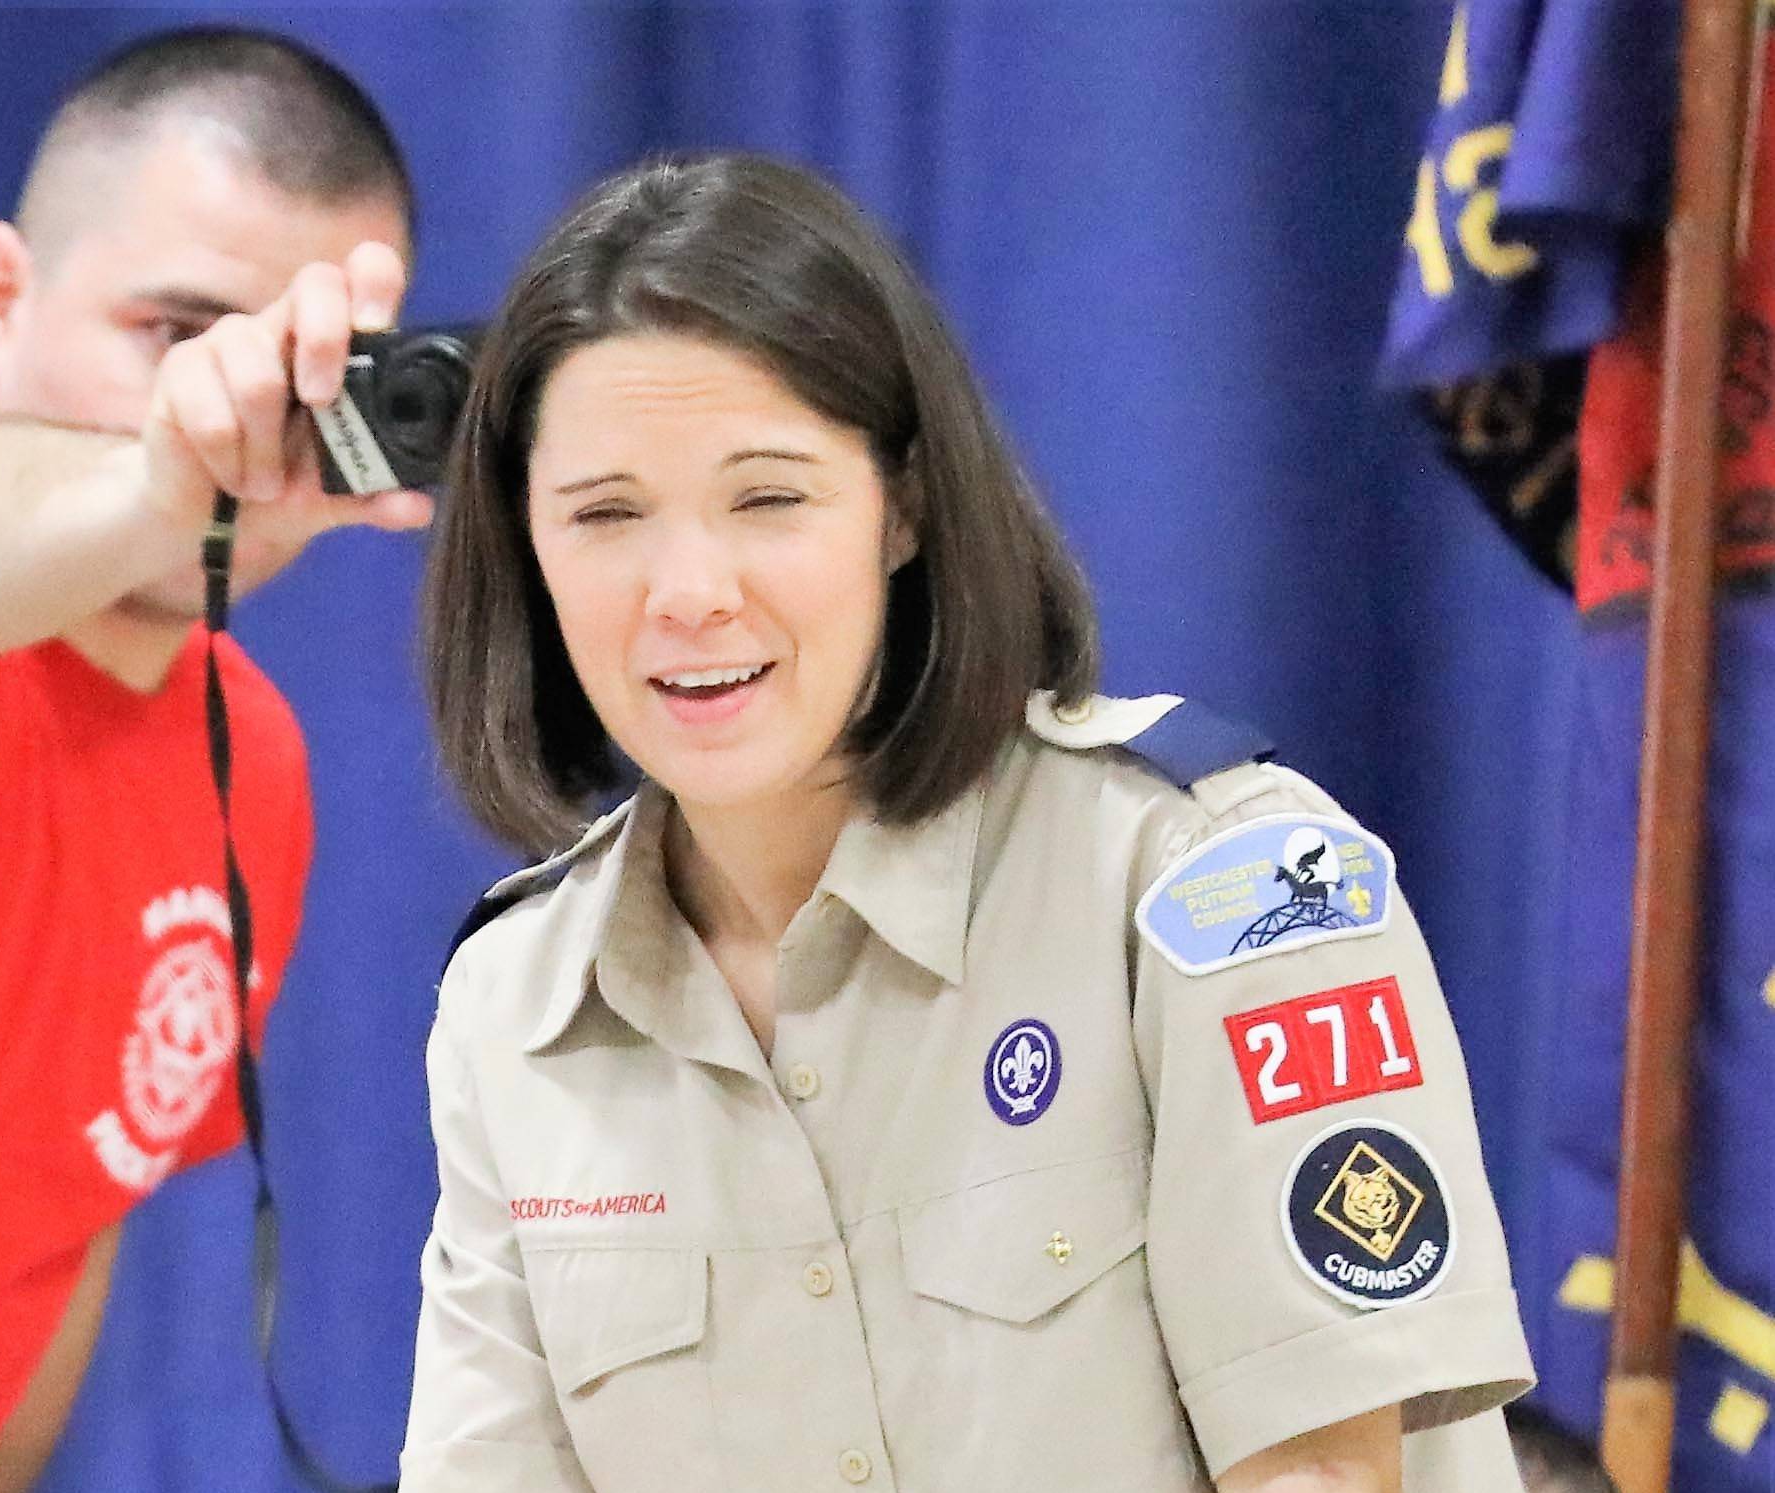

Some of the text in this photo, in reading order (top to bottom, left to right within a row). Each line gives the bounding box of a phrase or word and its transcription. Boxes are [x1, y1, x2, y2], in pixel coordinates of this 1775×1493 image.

[1245, 995, 1412, 1106] 271
[510, 1198, 574, 1220] SCOUTS
[589, 1191, 666, 1217] AMERICA
[1323, 1238, 1441, 1291] CUBMASTER
